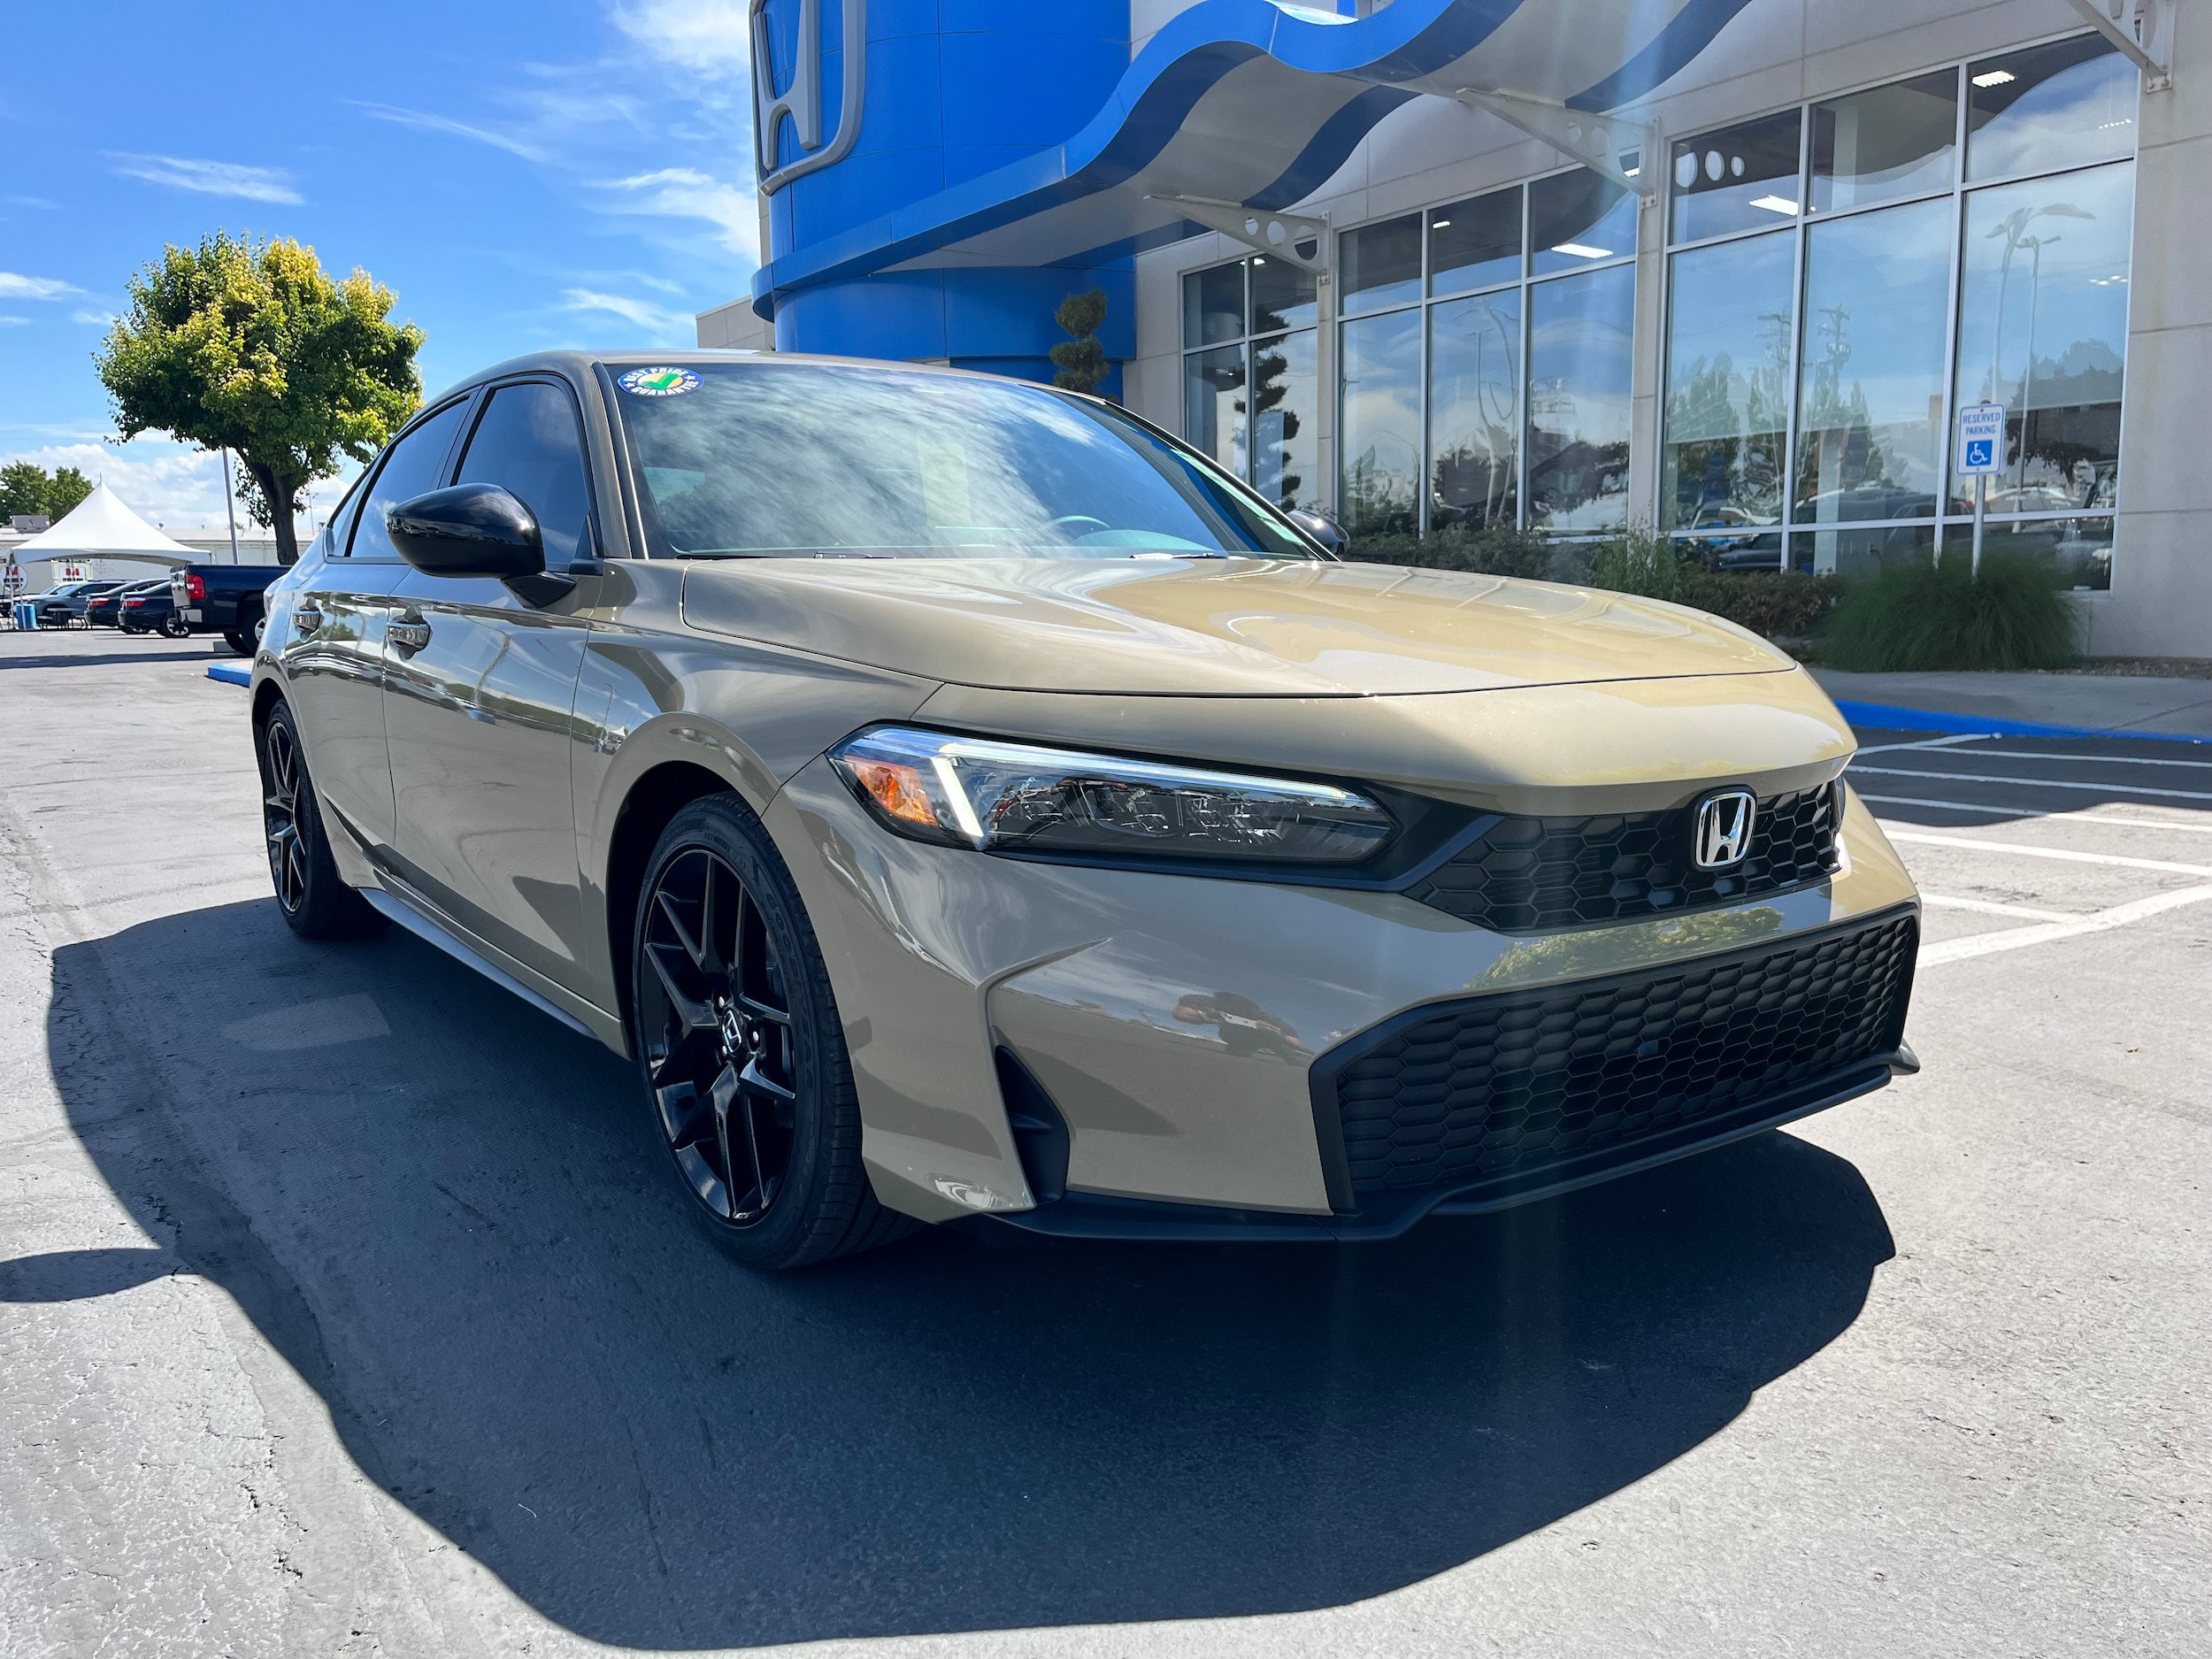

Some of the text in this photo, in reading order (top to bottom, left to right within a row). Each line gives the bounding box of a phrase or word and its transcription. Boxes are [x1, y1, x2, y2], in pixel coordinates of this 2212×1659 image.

[649, 367, 689, 377] PRICE
[1962, 412, 2001, 424] RESERVED
[1965, 425, 1996, 436] PARKING
